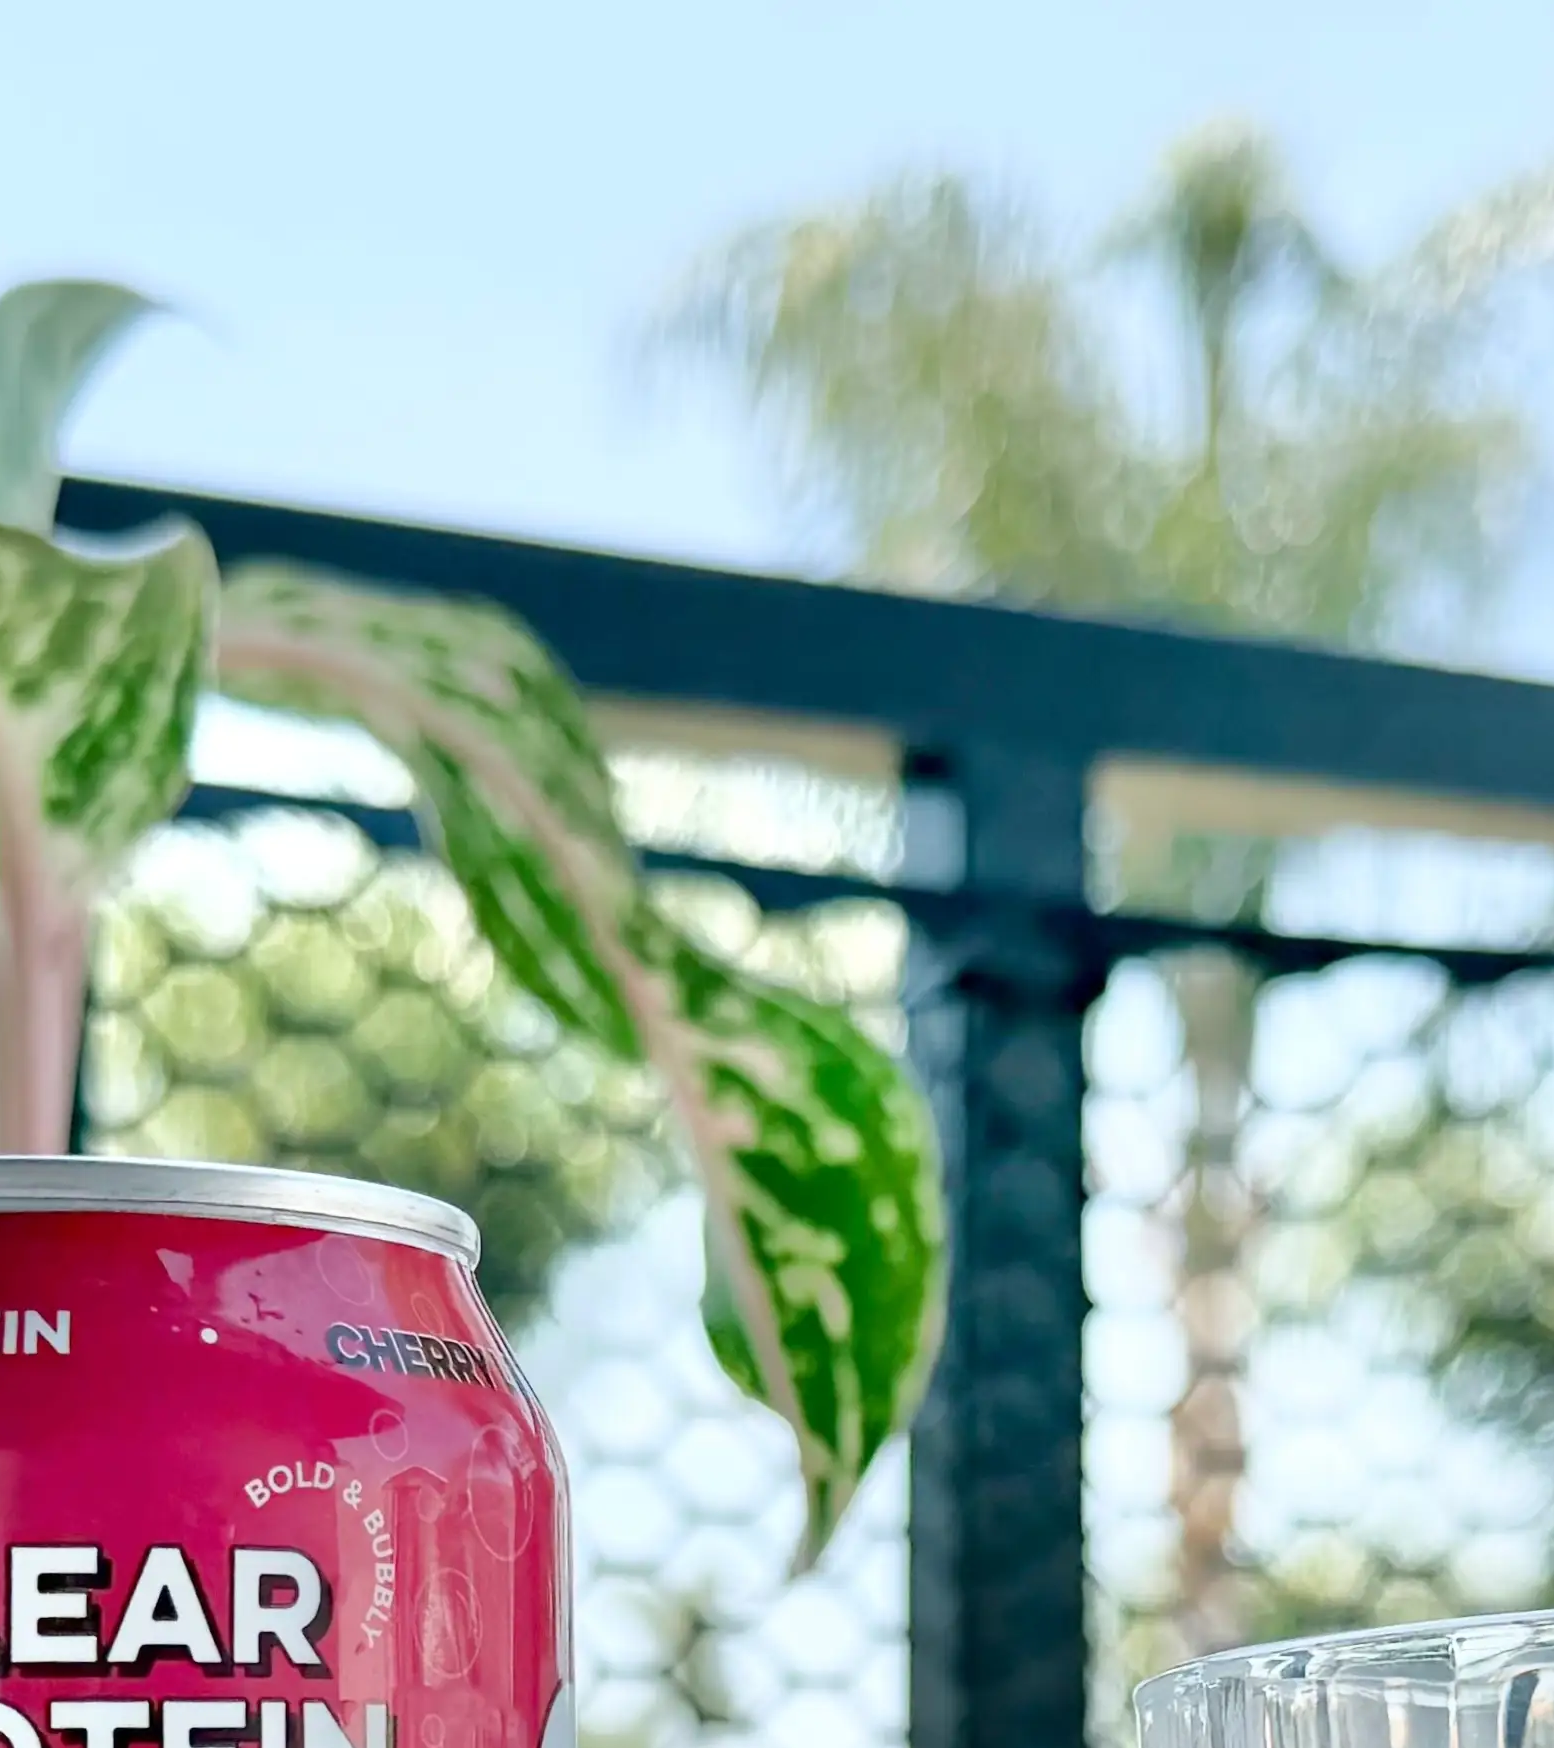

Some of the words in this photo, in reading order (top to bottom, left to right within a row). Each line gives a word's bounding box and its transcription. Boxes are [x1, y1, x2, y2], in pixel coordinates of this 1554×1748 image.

[326, 1321, 502, 1391] CHERRY
[244, 1461, 335, 1508] BOLD
[343, 1479, 363, 1510] &
[361, 1508, 395, 1649] BUBBLY
